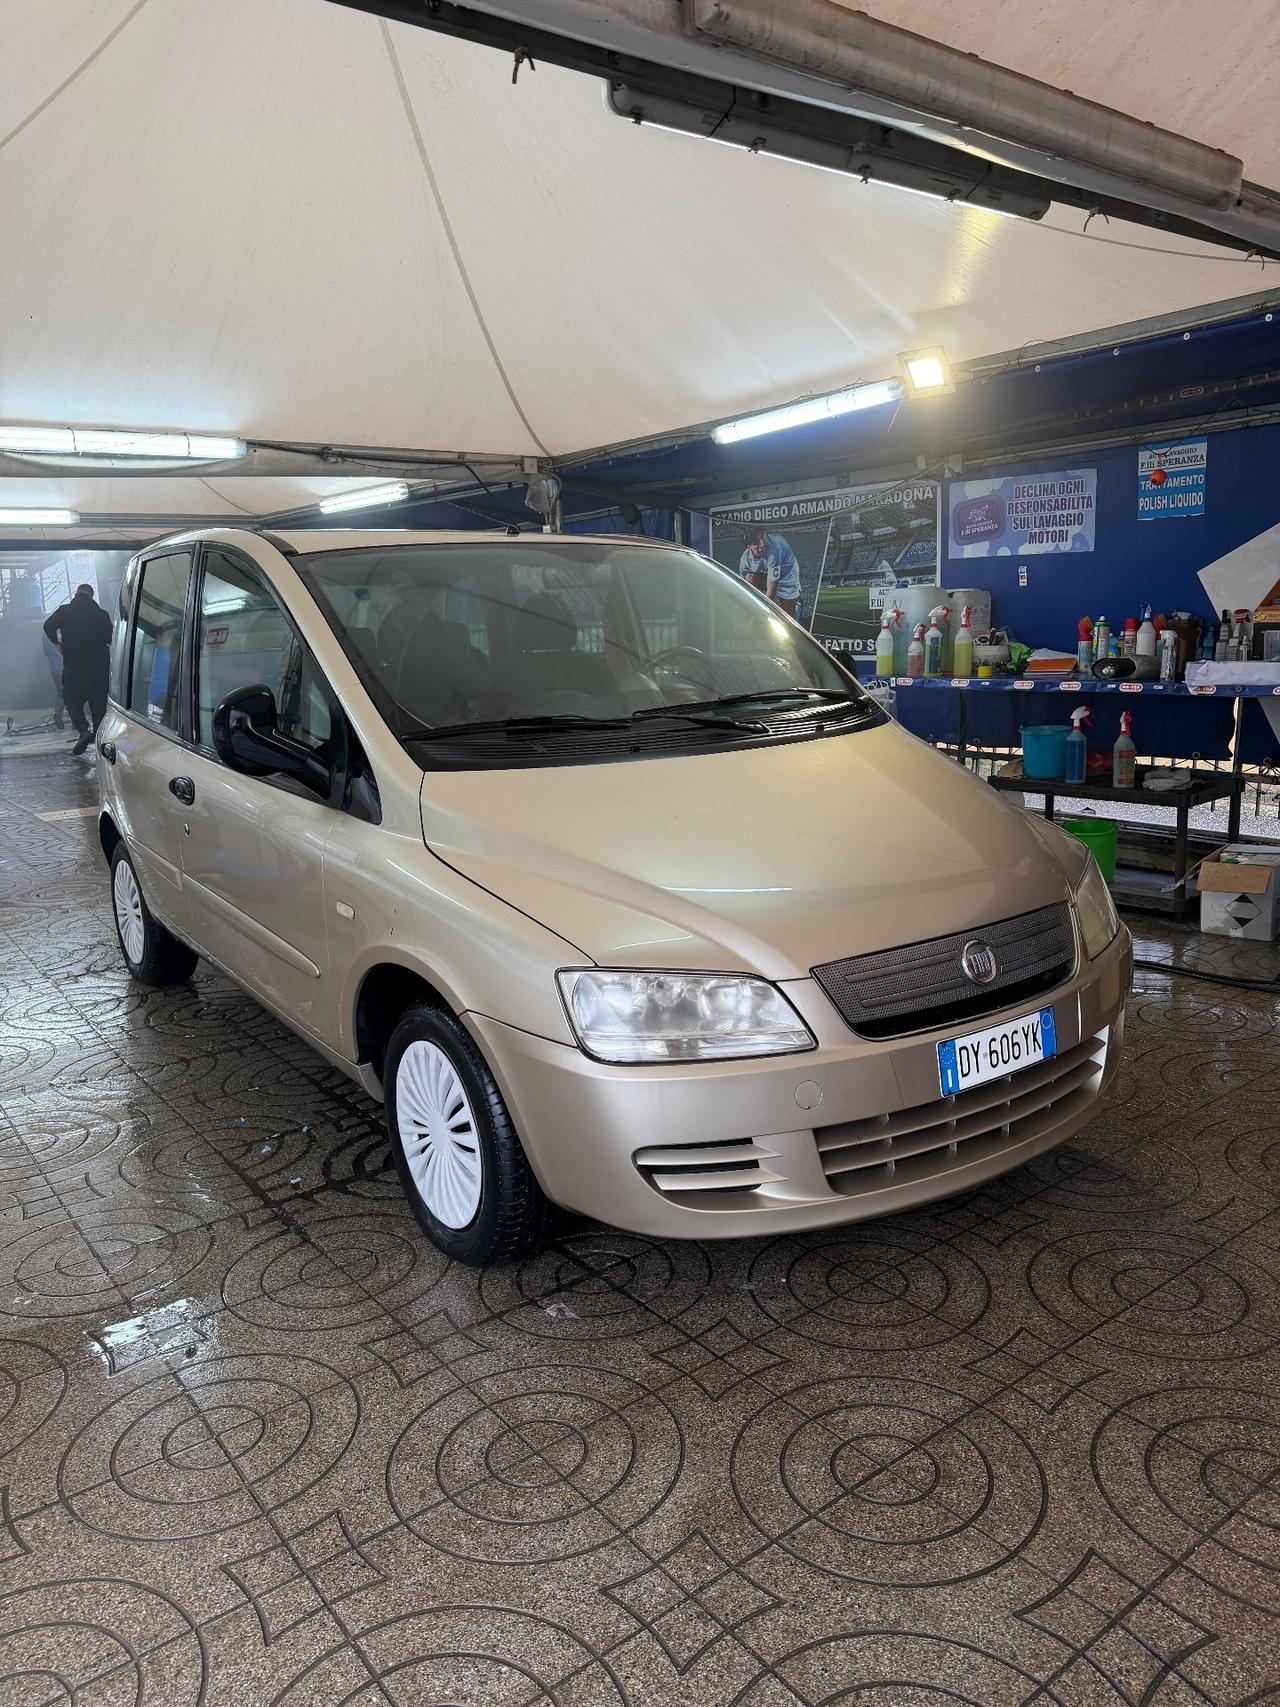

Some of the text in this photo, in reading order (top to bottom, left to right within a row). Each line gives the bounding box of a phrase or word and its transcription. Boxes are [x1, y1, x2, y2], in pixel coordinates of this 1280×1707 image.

[1157, 454, 1205, 468] SPERANZA
[1014, 480, 1085, 499] DECLINA OGNI
[754, 505, 788, 521] DIEGO
[791, 495, 852, 517] ARMANDO
[1008, 494, 1093, 515] RESPONSABILITÀ
[1139, 492, 1204, 511] POLISH LIQUIDO
[1012, 512, 1084, 530] SUL LAVAGGIO
[1028, 529, 1069, 544] MOTORI
[825, 638, 863, 652] FATTO
[958, 1020, 1042, 1078] DY 606YK
